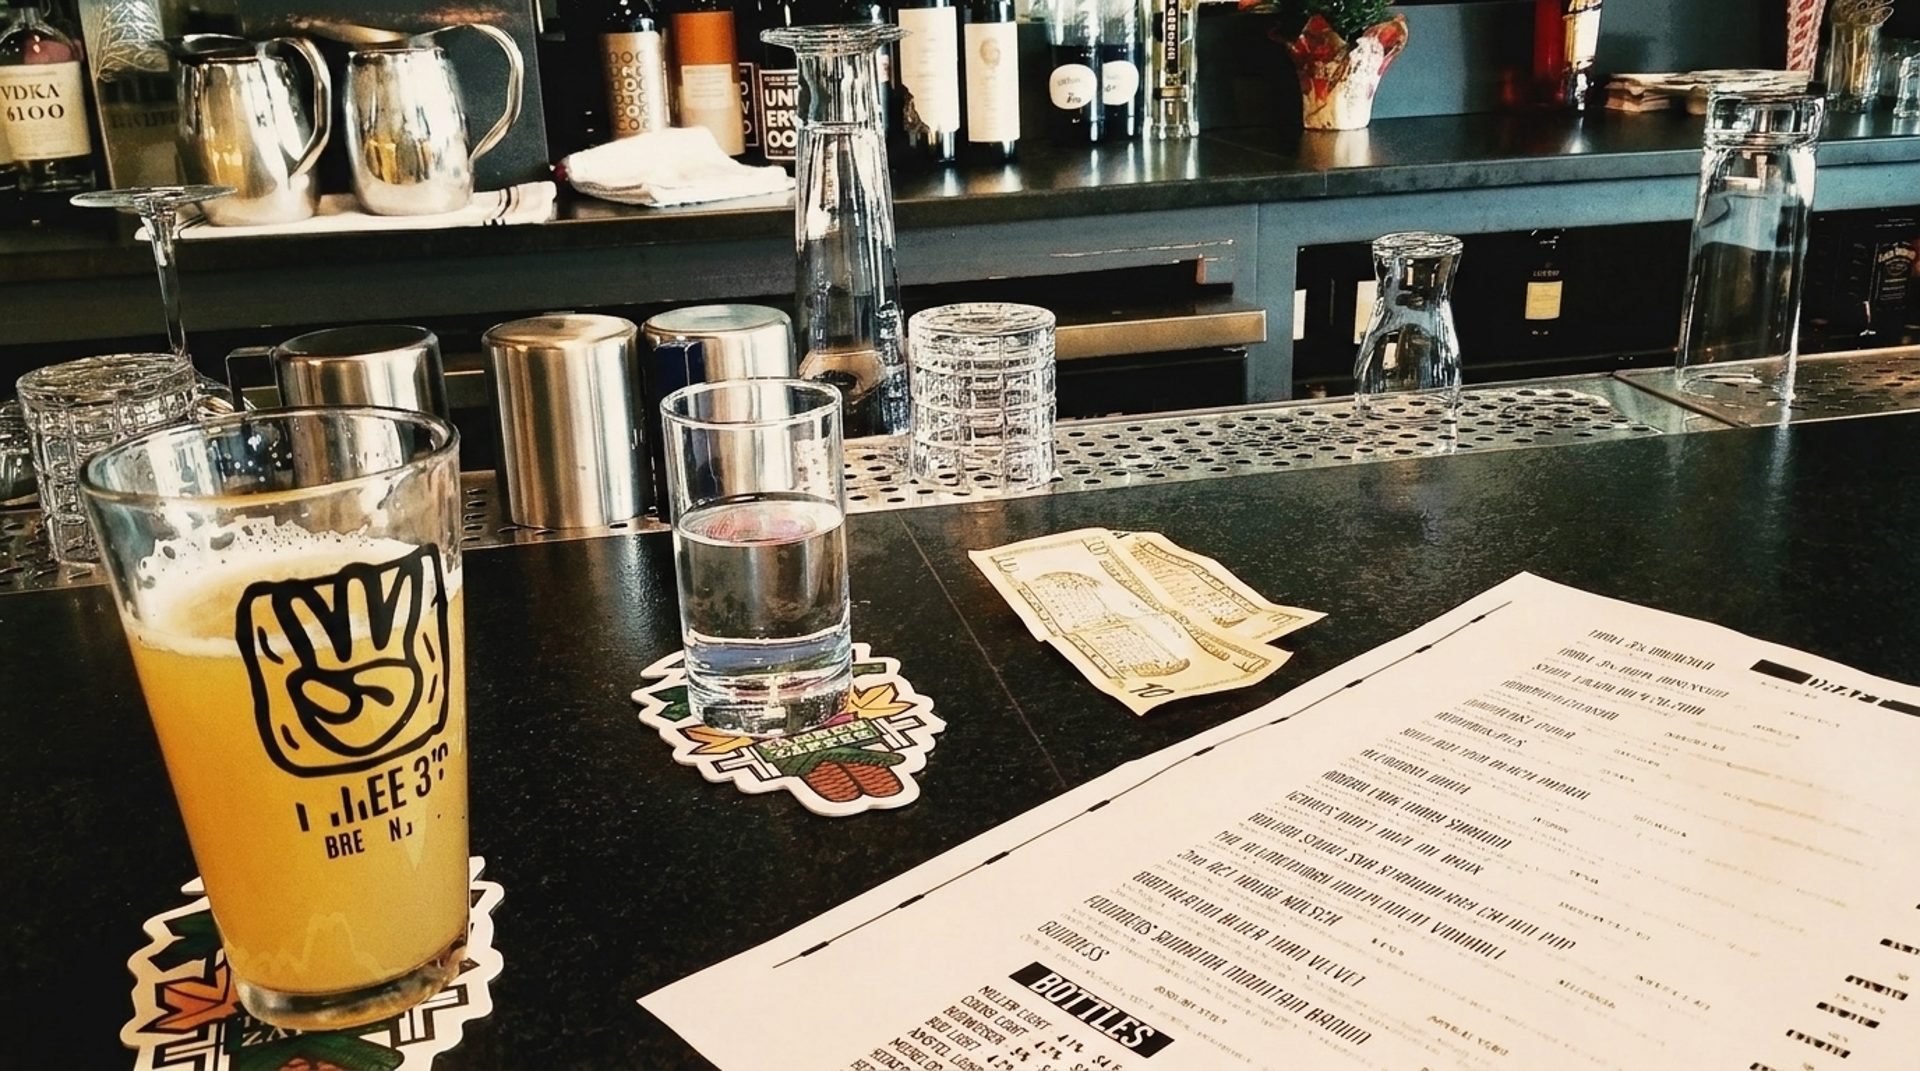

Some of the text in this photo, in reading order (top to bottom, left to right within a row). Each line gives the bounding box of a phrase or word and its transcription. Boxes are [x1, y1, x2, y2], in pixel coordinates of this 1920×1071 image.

[0, 83, 60, 101] VDKA
[764, 88, 799, 107] UN
[7, 103, 65, 122] 6100
[1028, 972, 1145, 1049] BOTTLES
